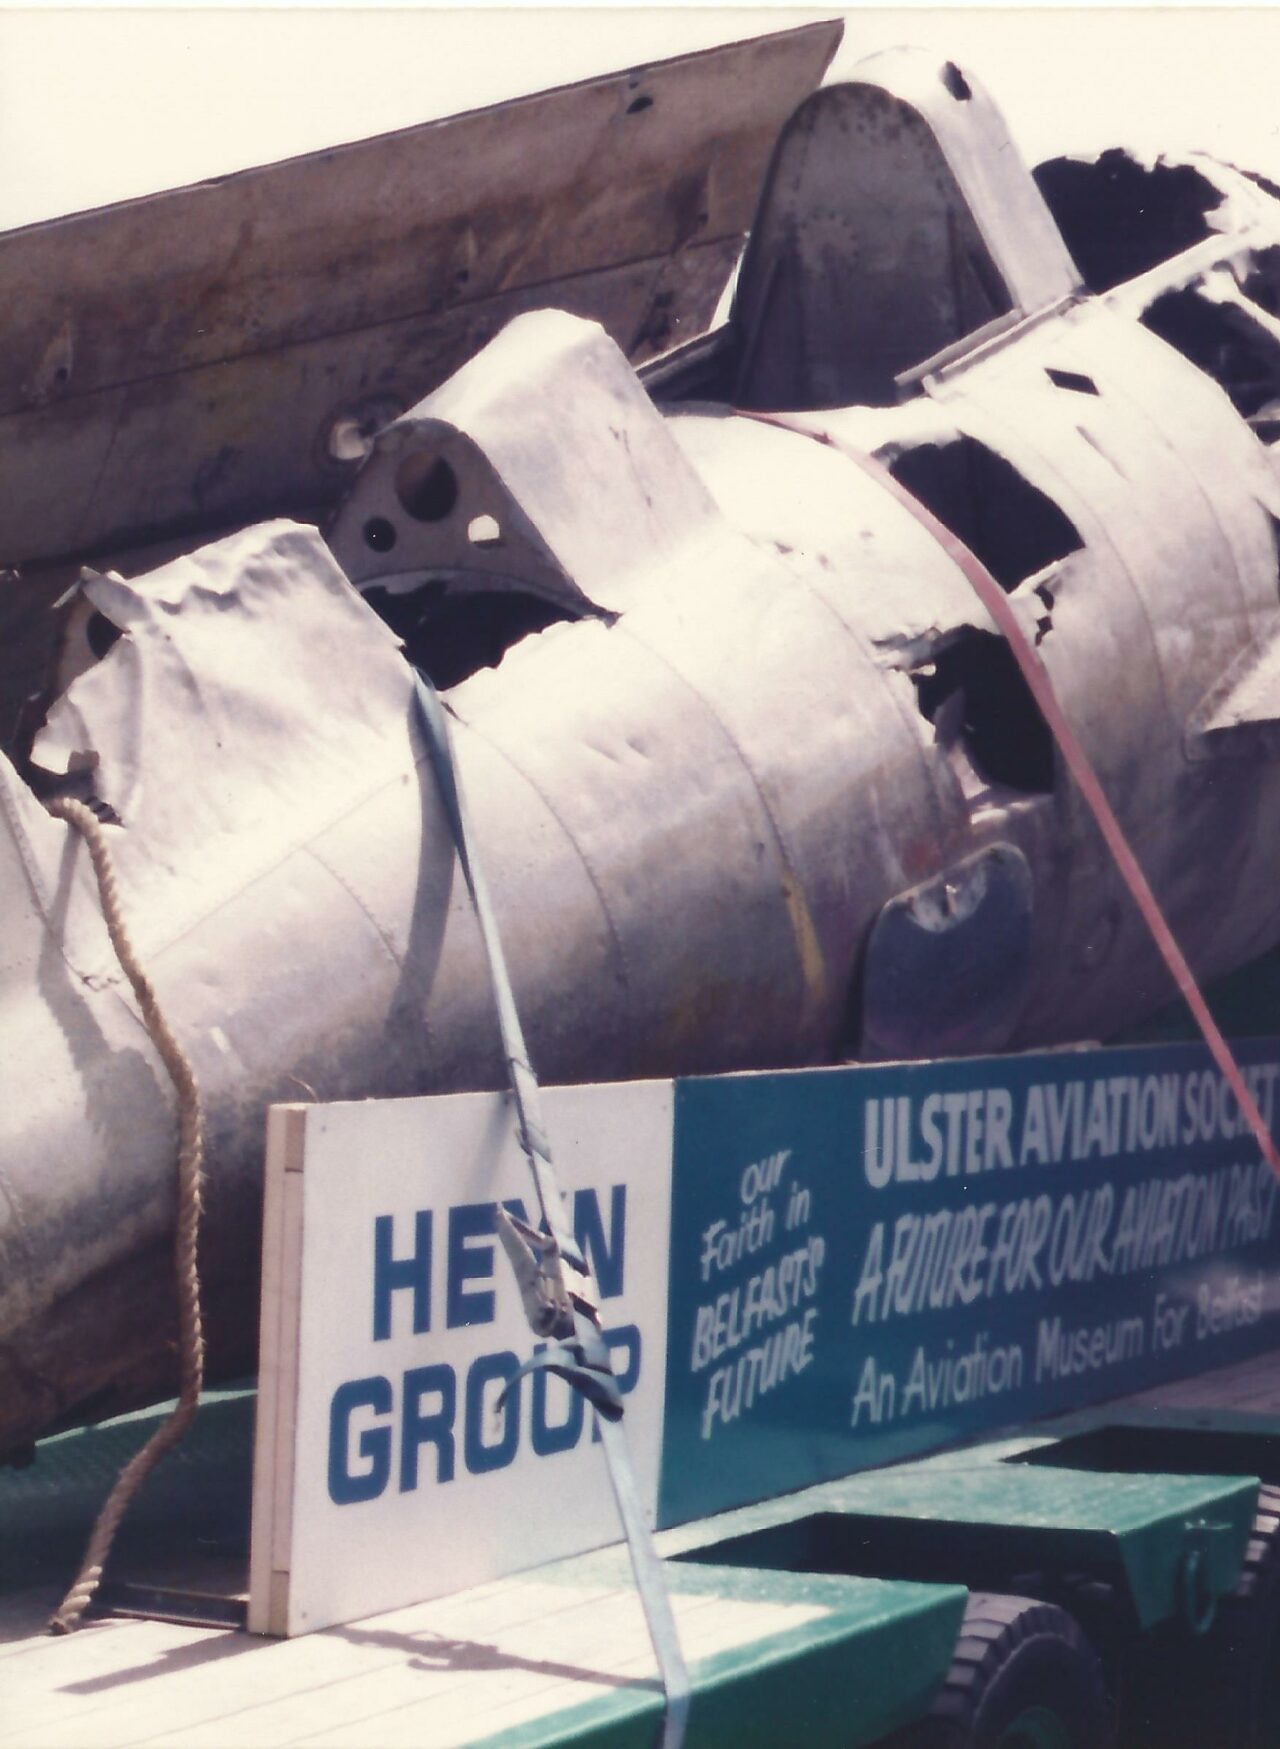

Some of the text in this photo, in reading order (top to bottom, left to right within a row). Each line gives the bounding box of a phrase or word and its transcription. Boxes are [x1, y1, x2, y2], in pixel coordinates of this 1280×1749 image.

[865, 1089, 1013, 1188] ULSTER
[1022, 1075, 1178, 1166] AVIATION
[700, 1182, 811, 1281] Faith in
[853, 1161, 1279, 1325] A FUTURE FOR OUR AVIATION PAST
[701, 1308, 818, 1438] FUTURE
[852, 1274, 1263, 1427] An Aviation Museum For Belfast
